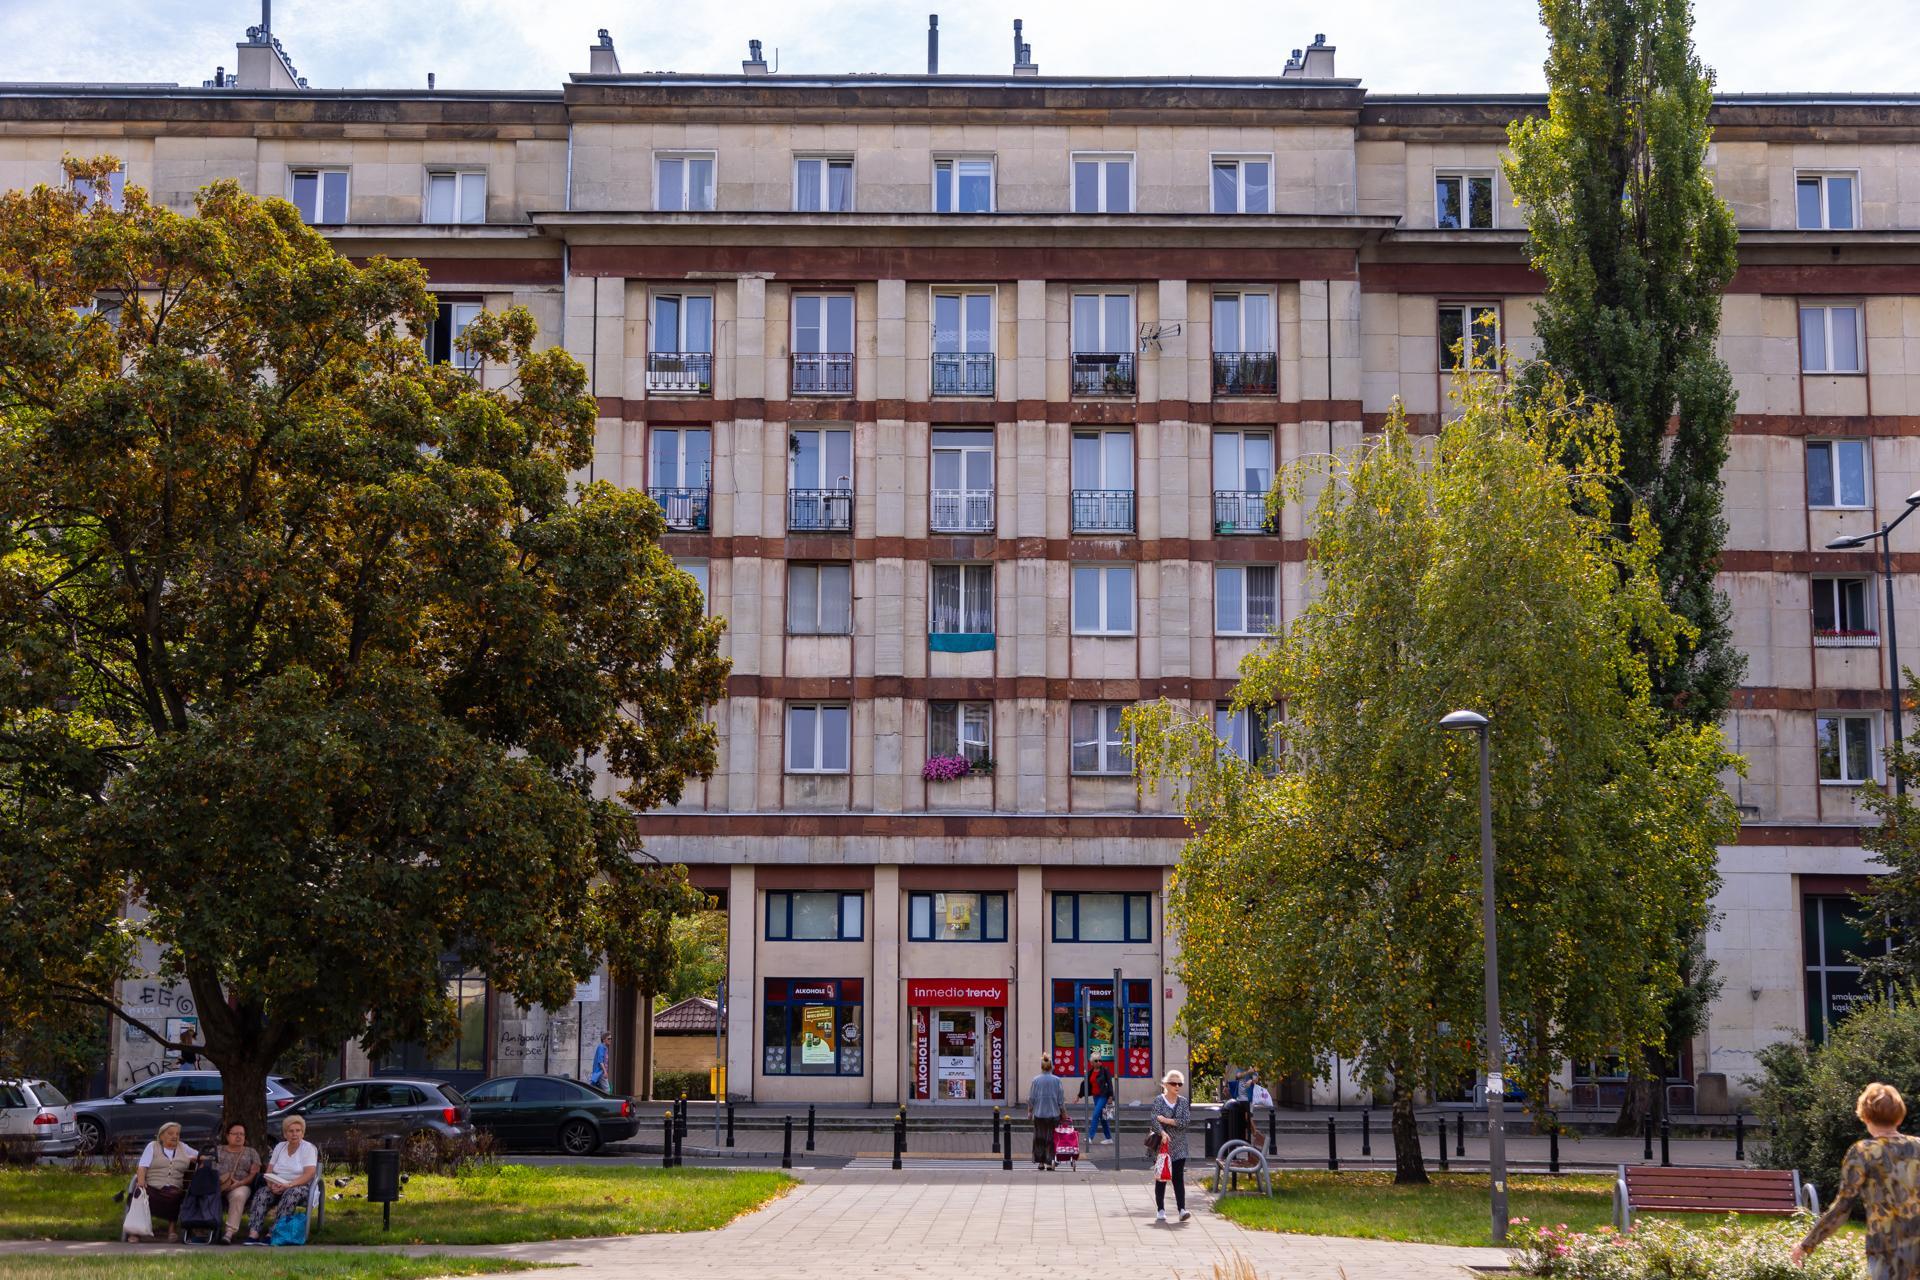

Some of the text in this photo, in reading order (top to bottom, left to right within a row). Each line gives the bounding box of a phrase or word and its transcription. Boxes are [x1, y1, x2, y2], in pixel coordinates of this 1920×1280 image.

[914, 987, 1001, 999] inmedio trendy
[919, 1037, 928, 1093] ALKOHOLE
[993, 1036, 1002, 1093] PAPIEROSY
